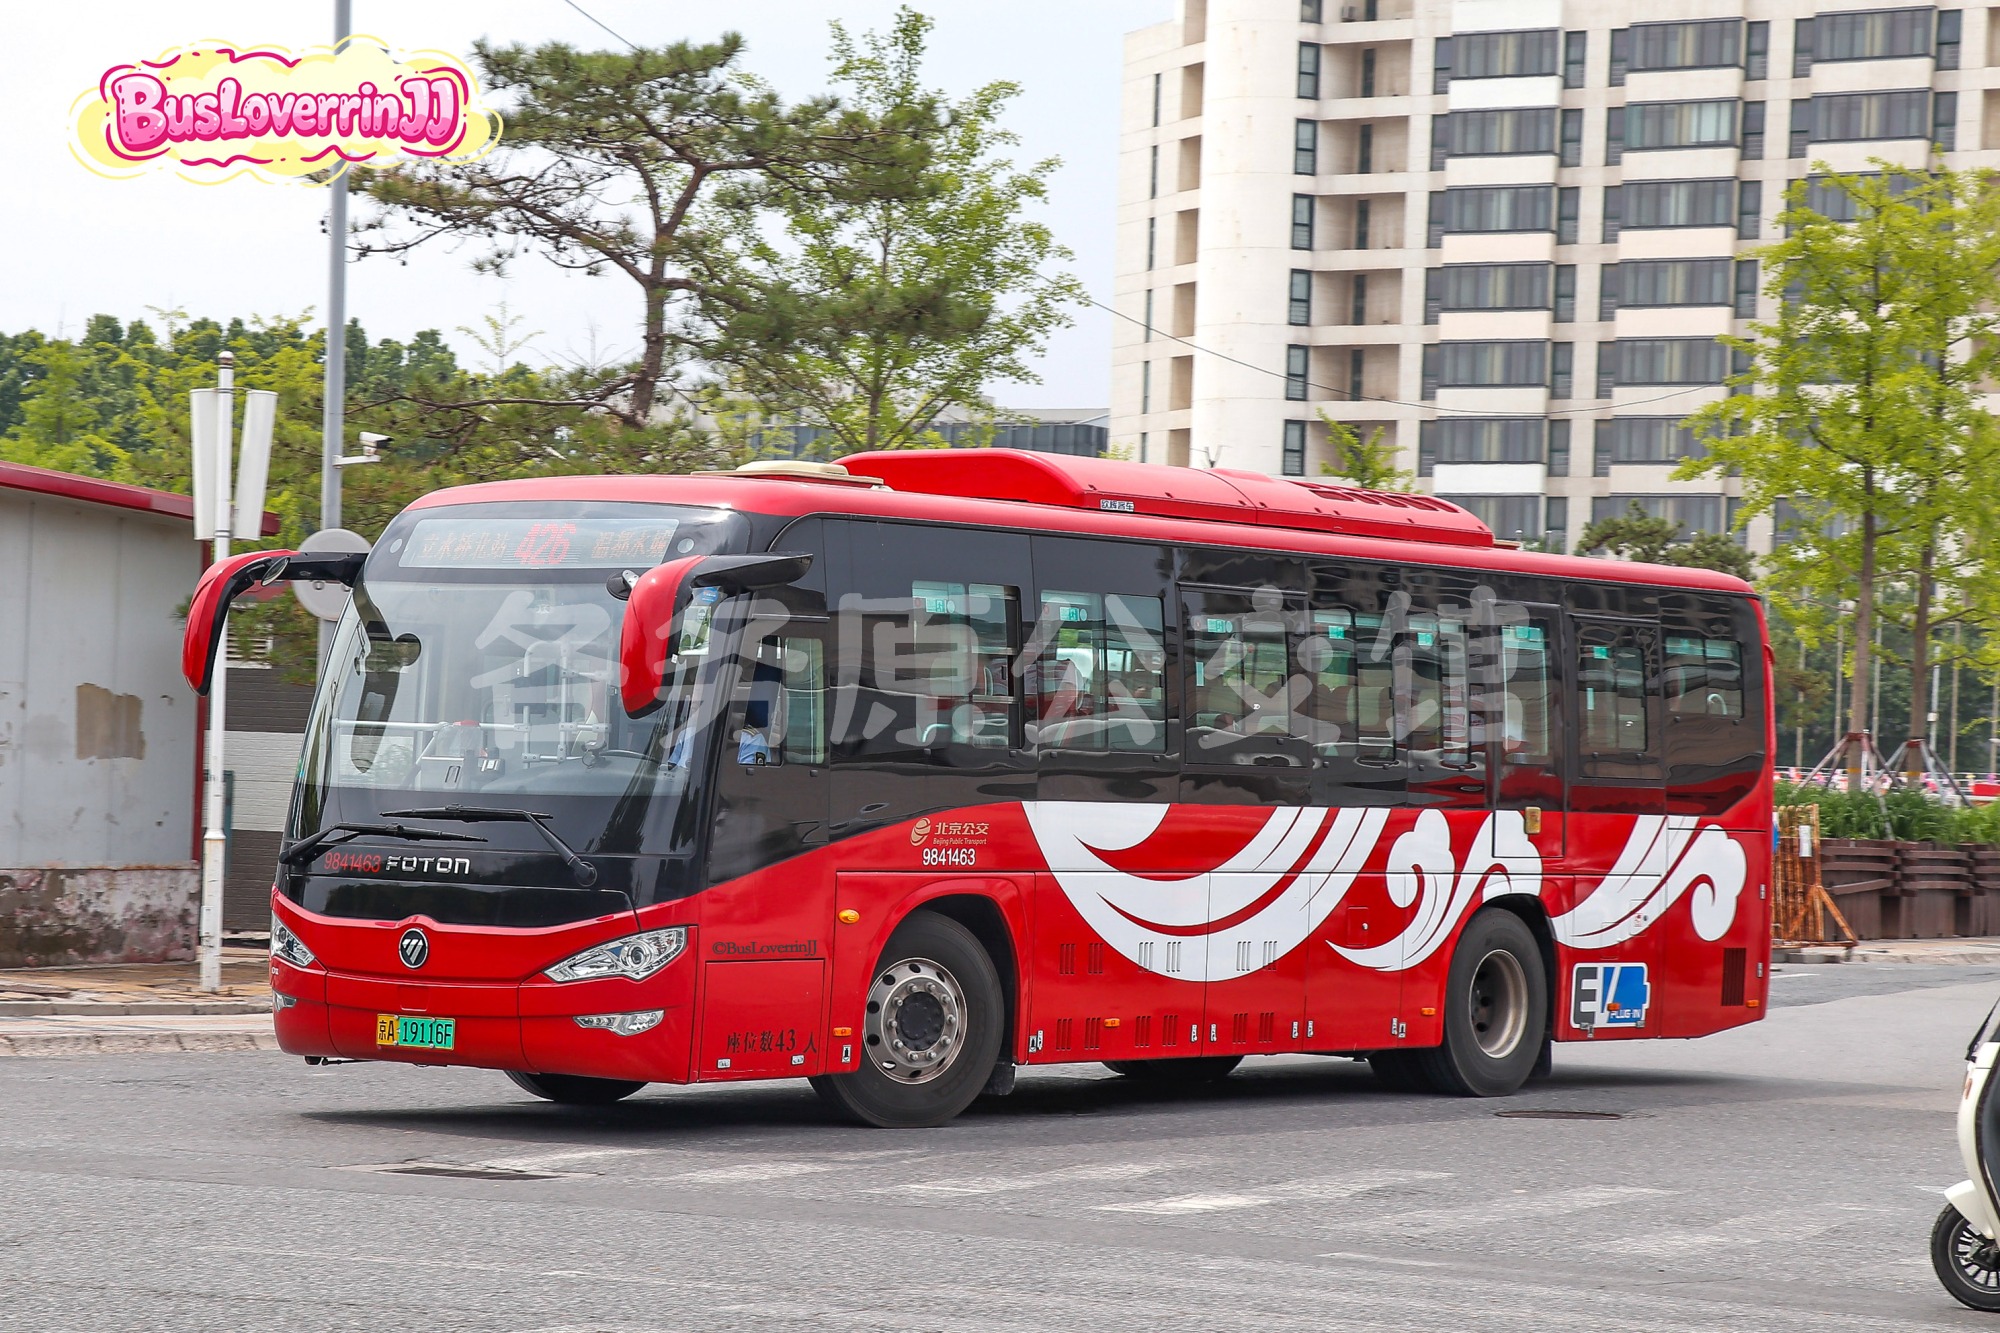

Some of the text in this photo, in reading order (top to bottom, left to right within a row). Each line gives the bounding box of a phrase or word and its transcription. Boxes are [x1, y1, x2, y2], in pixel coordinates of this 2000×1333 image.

[513, 522, 577, 564] 426
[934, 822, 989, 835] 北京公交
[933, 837, 987, 847] Beijing Public Transport
[324, 852, 470, 875] 9841463 FOTON
[922, 848, 975, 865] 9841463
